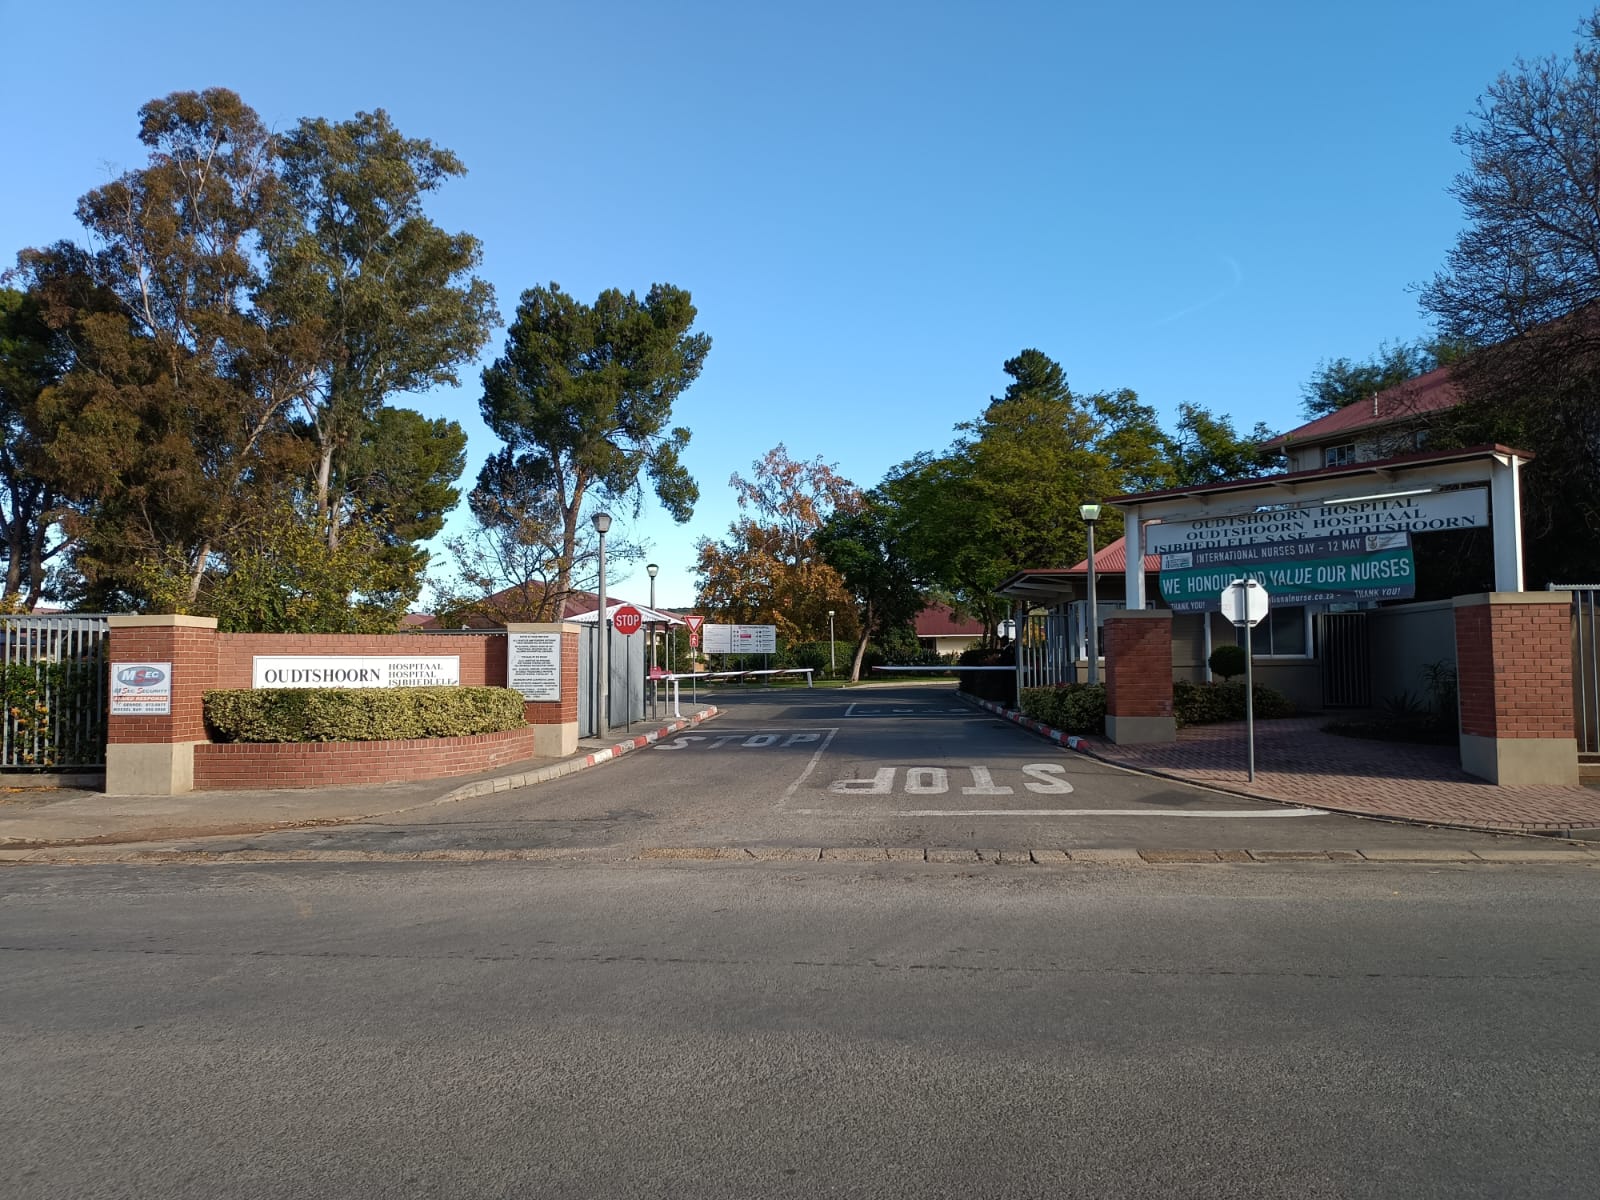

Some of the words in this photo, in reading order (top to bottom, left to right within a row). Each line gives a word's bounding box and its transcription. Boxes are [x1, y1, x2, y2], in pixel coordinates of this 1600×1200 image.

[1192, 509, 1311, 530] OUDTSHOORN
[1320, 498, 1419, 517] HOSPITAL
[1186, 521, 1304, 540] OUDTSHOORN
[1313, 509, 1427, 529] HOSPITAAL
[1329, 515, 1475, 537] OUDTSHOORN
[1196, 549, 1258, 564] INTERNATIONAL
[1261, 545, 1296, 559] NURSES
[1298, 543, 1315, 555] DAY
[1328, 541, 1339, 551] 12
[1342, 538, 1360, 550] MAY
[1162, 578, 1181, 595] WE
[1269, 567, 1313, 586] VALUE
[1317, 565, 1346, 584] OUR
[1350, 557, 1410, 581] NURSES
[1354, 588, 1379, 599] THANK
[1381, 587, 1400, 597] YOU!
[1169, 602, 1190, 610] THANK
[1190, 601, 1206, 610] YOU!
[616, 614, 640, 627] STOP
[264, 668, 381, 683] OUDTSHOORN
[388, 663, 443, 671] HOSPITAAL
[388, 671, 436, 679] HOSPITAL
[654, 733, 822, 751] STOP
[829, 763, 1074, 795] STOP
